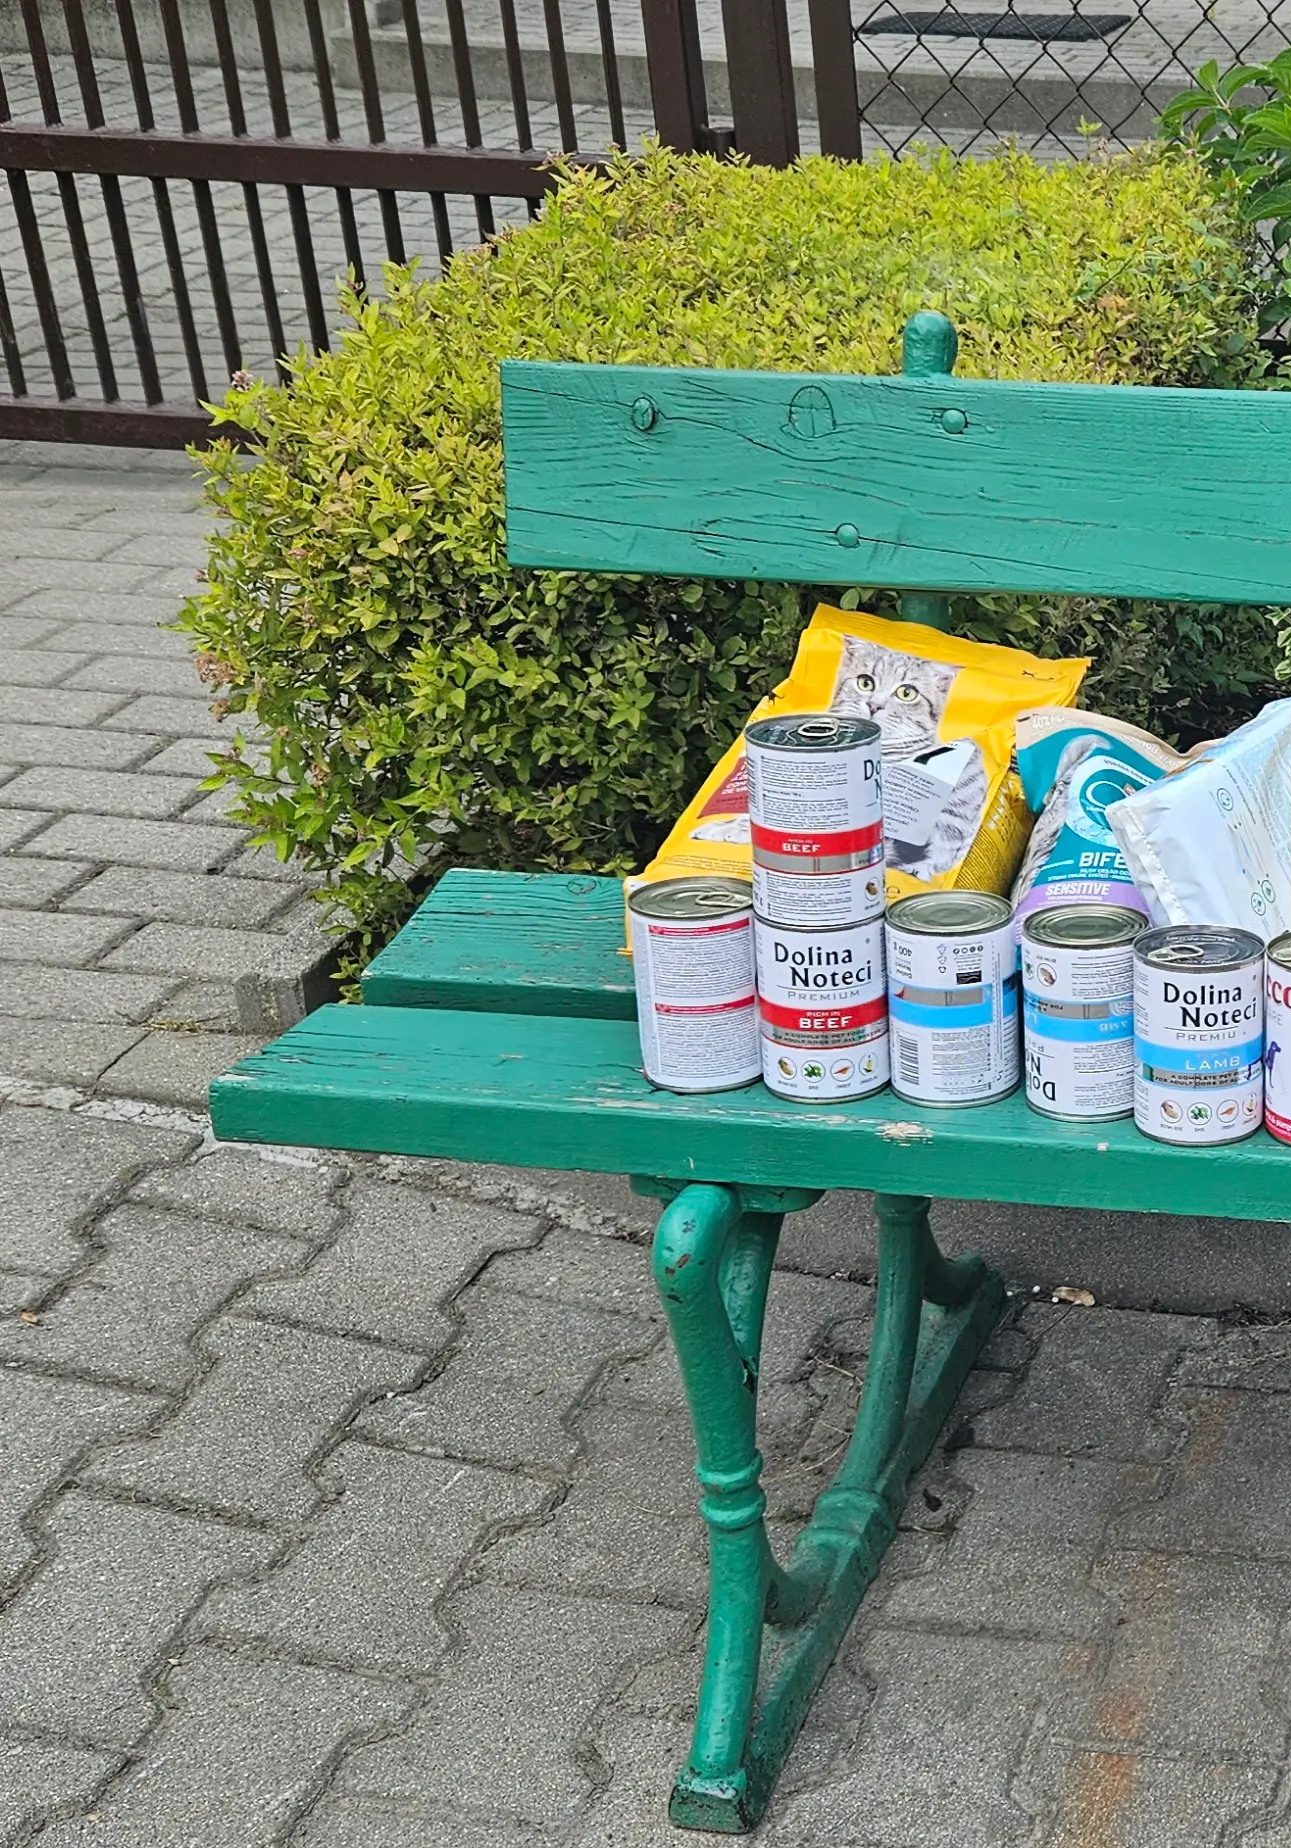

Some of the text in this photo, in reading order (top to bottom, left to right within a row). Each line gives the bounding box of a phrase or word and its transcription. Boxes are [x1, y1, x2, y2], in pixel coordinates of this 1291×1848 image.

[781, 843, 822, 853] BEEF
[1045, 882, 1111, 896] SENSITIVE
[774, 942, 853, 966] Dolina
[789, 960, 872, 988] Noteci
[787, 989, 860, 1001] PREMIUM
[1163, 981, 1242, 1006] Dolina
[1181, 997, 1257, 1028] Noteci
[799, 1016, 853, 1029] BEEF
[1176, 1031, 1247, 1041] PREMIU
[1185, 1056, 1241, 1071] LAMB
